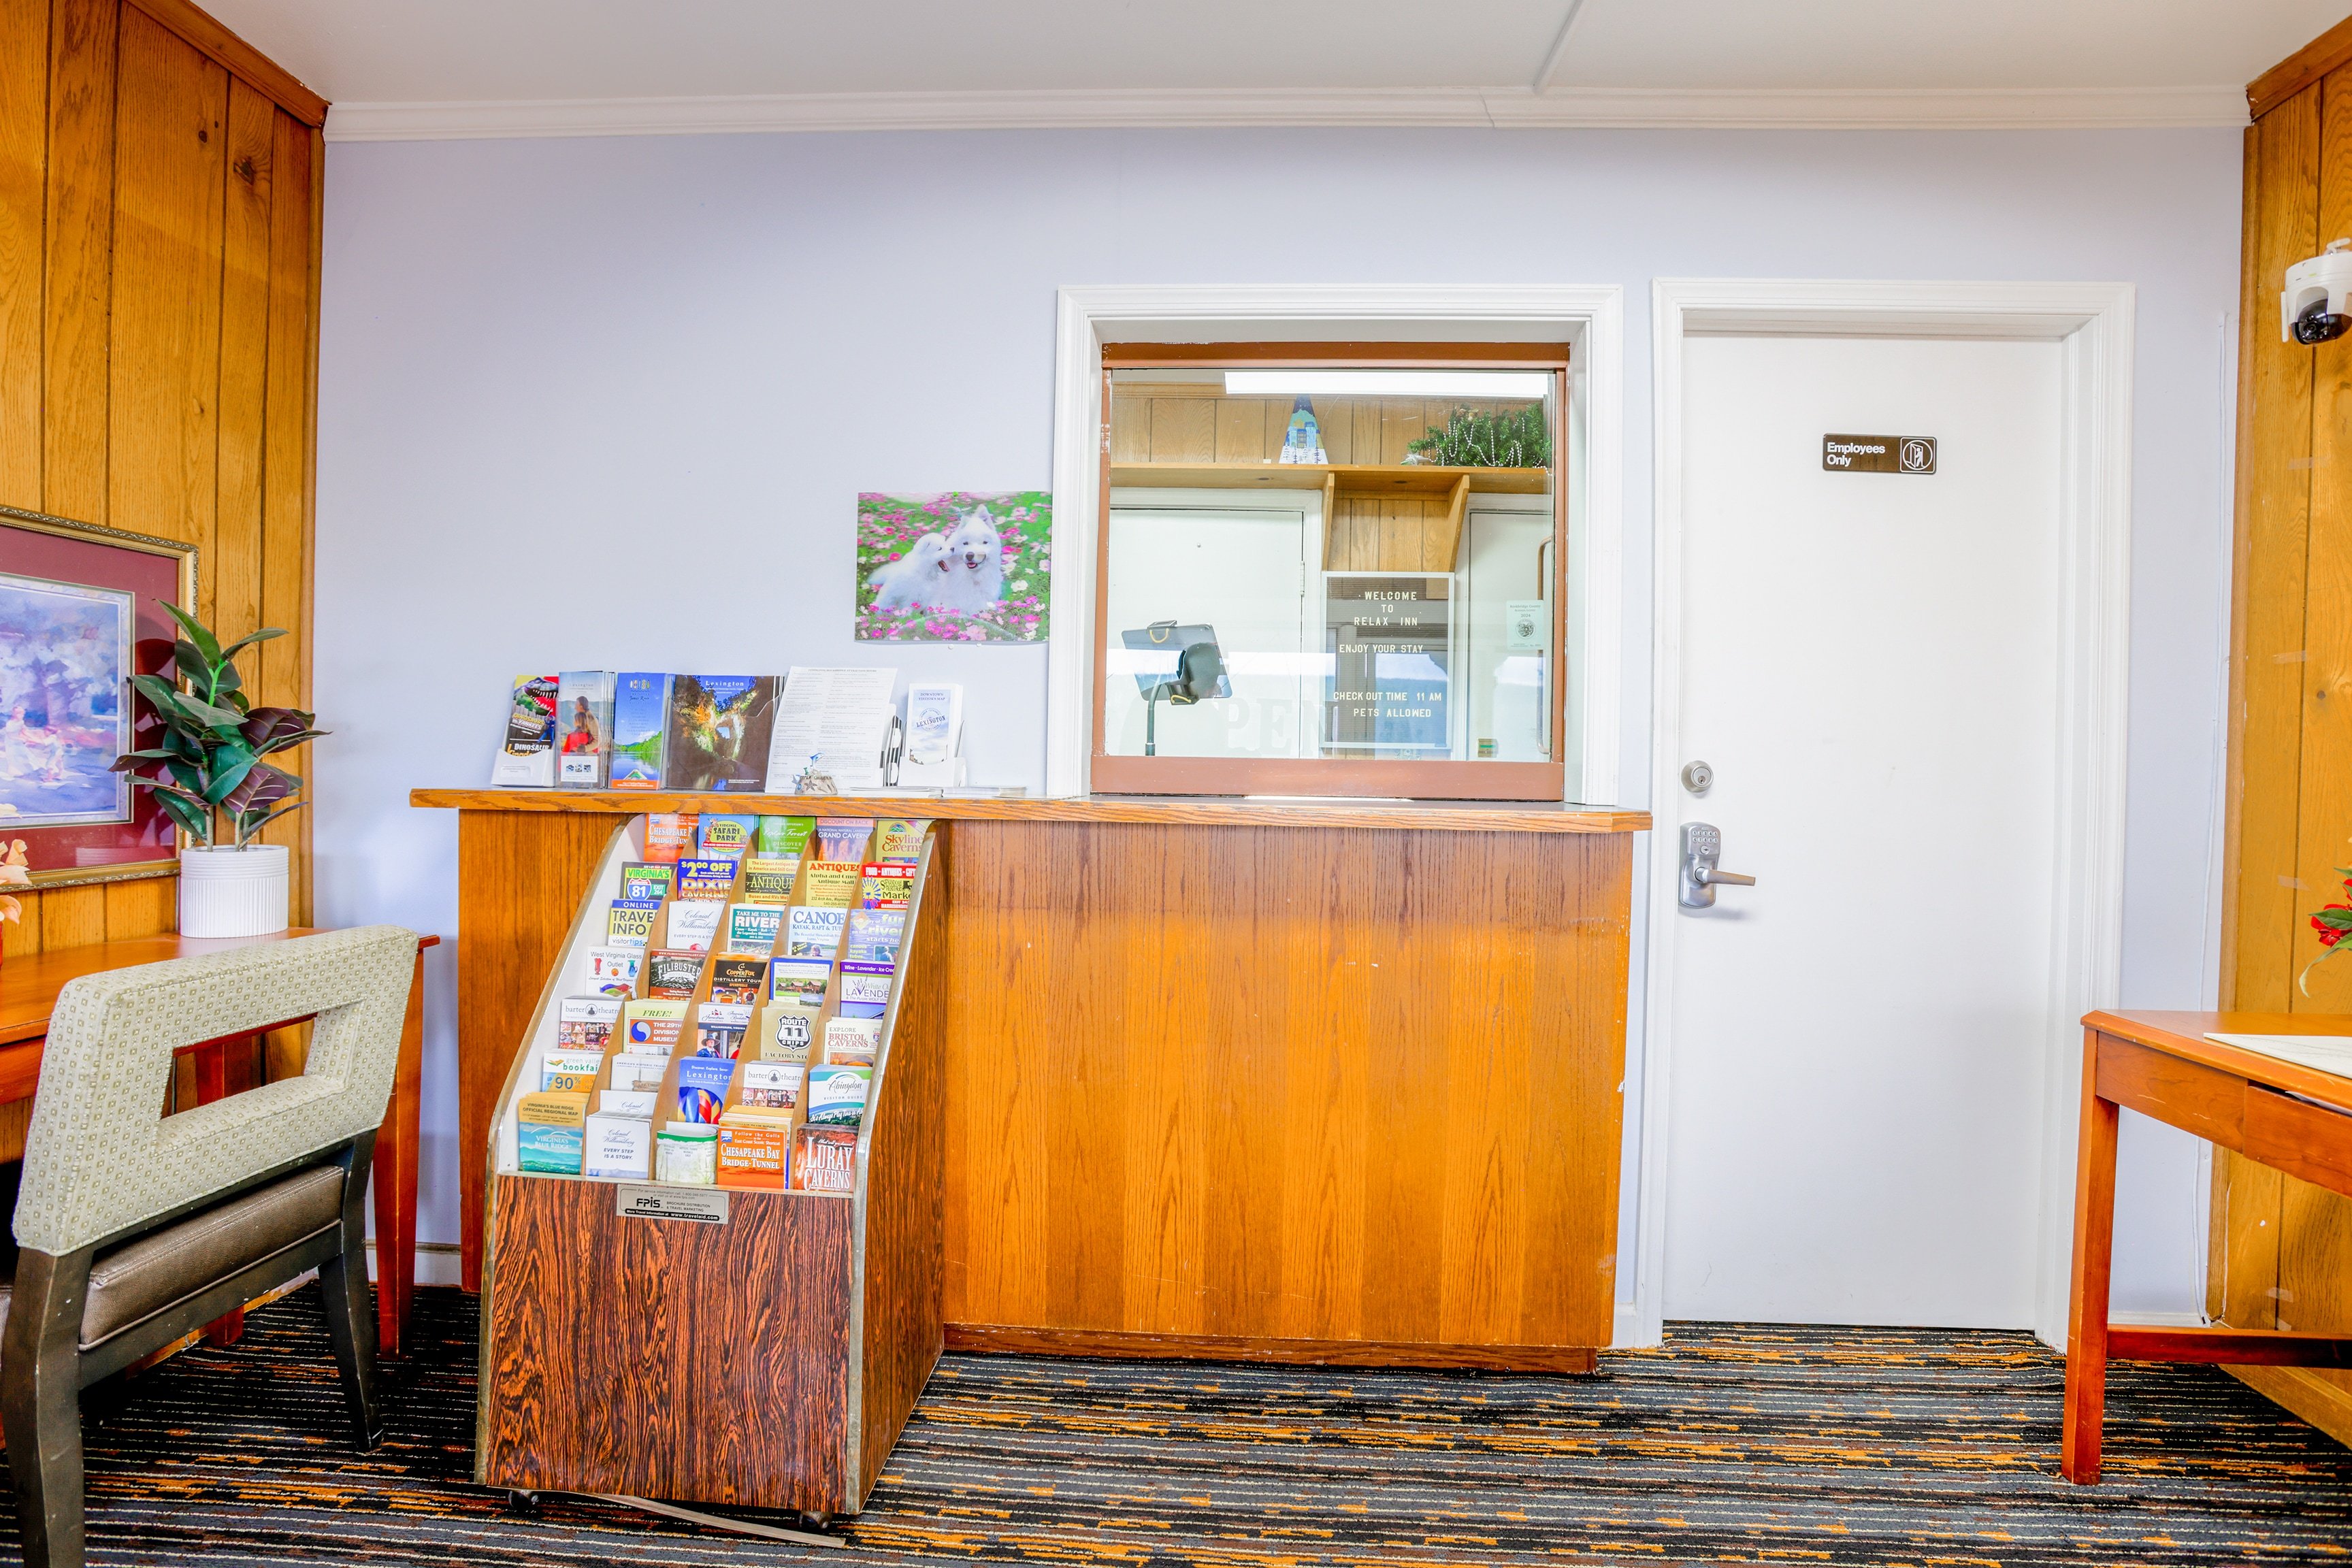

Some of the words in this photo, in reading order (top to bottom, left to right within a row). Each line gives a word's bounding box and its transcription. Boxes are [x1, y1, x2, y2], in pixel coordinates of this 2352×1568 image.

[1827, 442, 1886, 455] Employees
[1827, 454, 1852, 467] Only
[1365, 591, 1417, 600] WELCOME
[1381, 604, 1394, 612] TO
[1354, 617, 1388, 626] RELAX
[1401, 617, 1418, 626] INN
[1339, 644, 1369, 653] ENJOY
[1373, 644, 1396, 653] YOUR
[1401, 644, 1423, 653] STAY
[1333, 691, 1364, 700] CHECK
[1366, 692, 1383, 700] OUT
[1386, 692, 1407, 701] TIME
[1416, 692, 1425, 701] 11
[1429, 692, 1442, 701] AM
[1354, 708, 1379, 717] PETS
[1386, 708, 1431, 717] ALLOWED
[916, 715, 946, 728] LEXINGTON
[649, 824, 687, 836] CHESAPEAKE
[885, 834, 924, 844] Skyline
[710, 862, 732, 872] OFF
[865, 867, 878, 876] FOOD
[627, 868, 670, 879] VIRGINIA'S
[681, 877, 733, 892] DIXIE
[750, 876, 795, 892] ANTIQUE
[632, 885, 647, 898] 81
[684, 909, 713, 919] Colonial
[793, 910, 845, 926] CANOE
[734, 917, 780, 928] RIVER
[612, 924, 647, 936] INFO
[657, 962, 702, 980] FILIBUSTER
[846, 987, 889, 998] LAVENDE
[781, 1018, 807, 1026] ROUTE
[783, 1026, 804, 1037] 11
[828, 1032, 866, 1041] BRISTOL
[828, 1040, 868, 1048] CAVERNS
[563, 1063, 598, 1072] bookfai
[828, 1079, 862, 1094] Abingdon
[607, 1128, 631, 1137] Colonial
[536, 1135, 569, 1144] VIRGINIA'S
[721, 1143, 766, 1158] CHESAPEAKE
[766, 1145, 781, 1160] BAY
[806, 1137, 853, 1171] LURAY
[721, 1156, 780, 1169] BRIDGE-TUNNEL
[803, 1169, 850, 1191] CAVERNS
